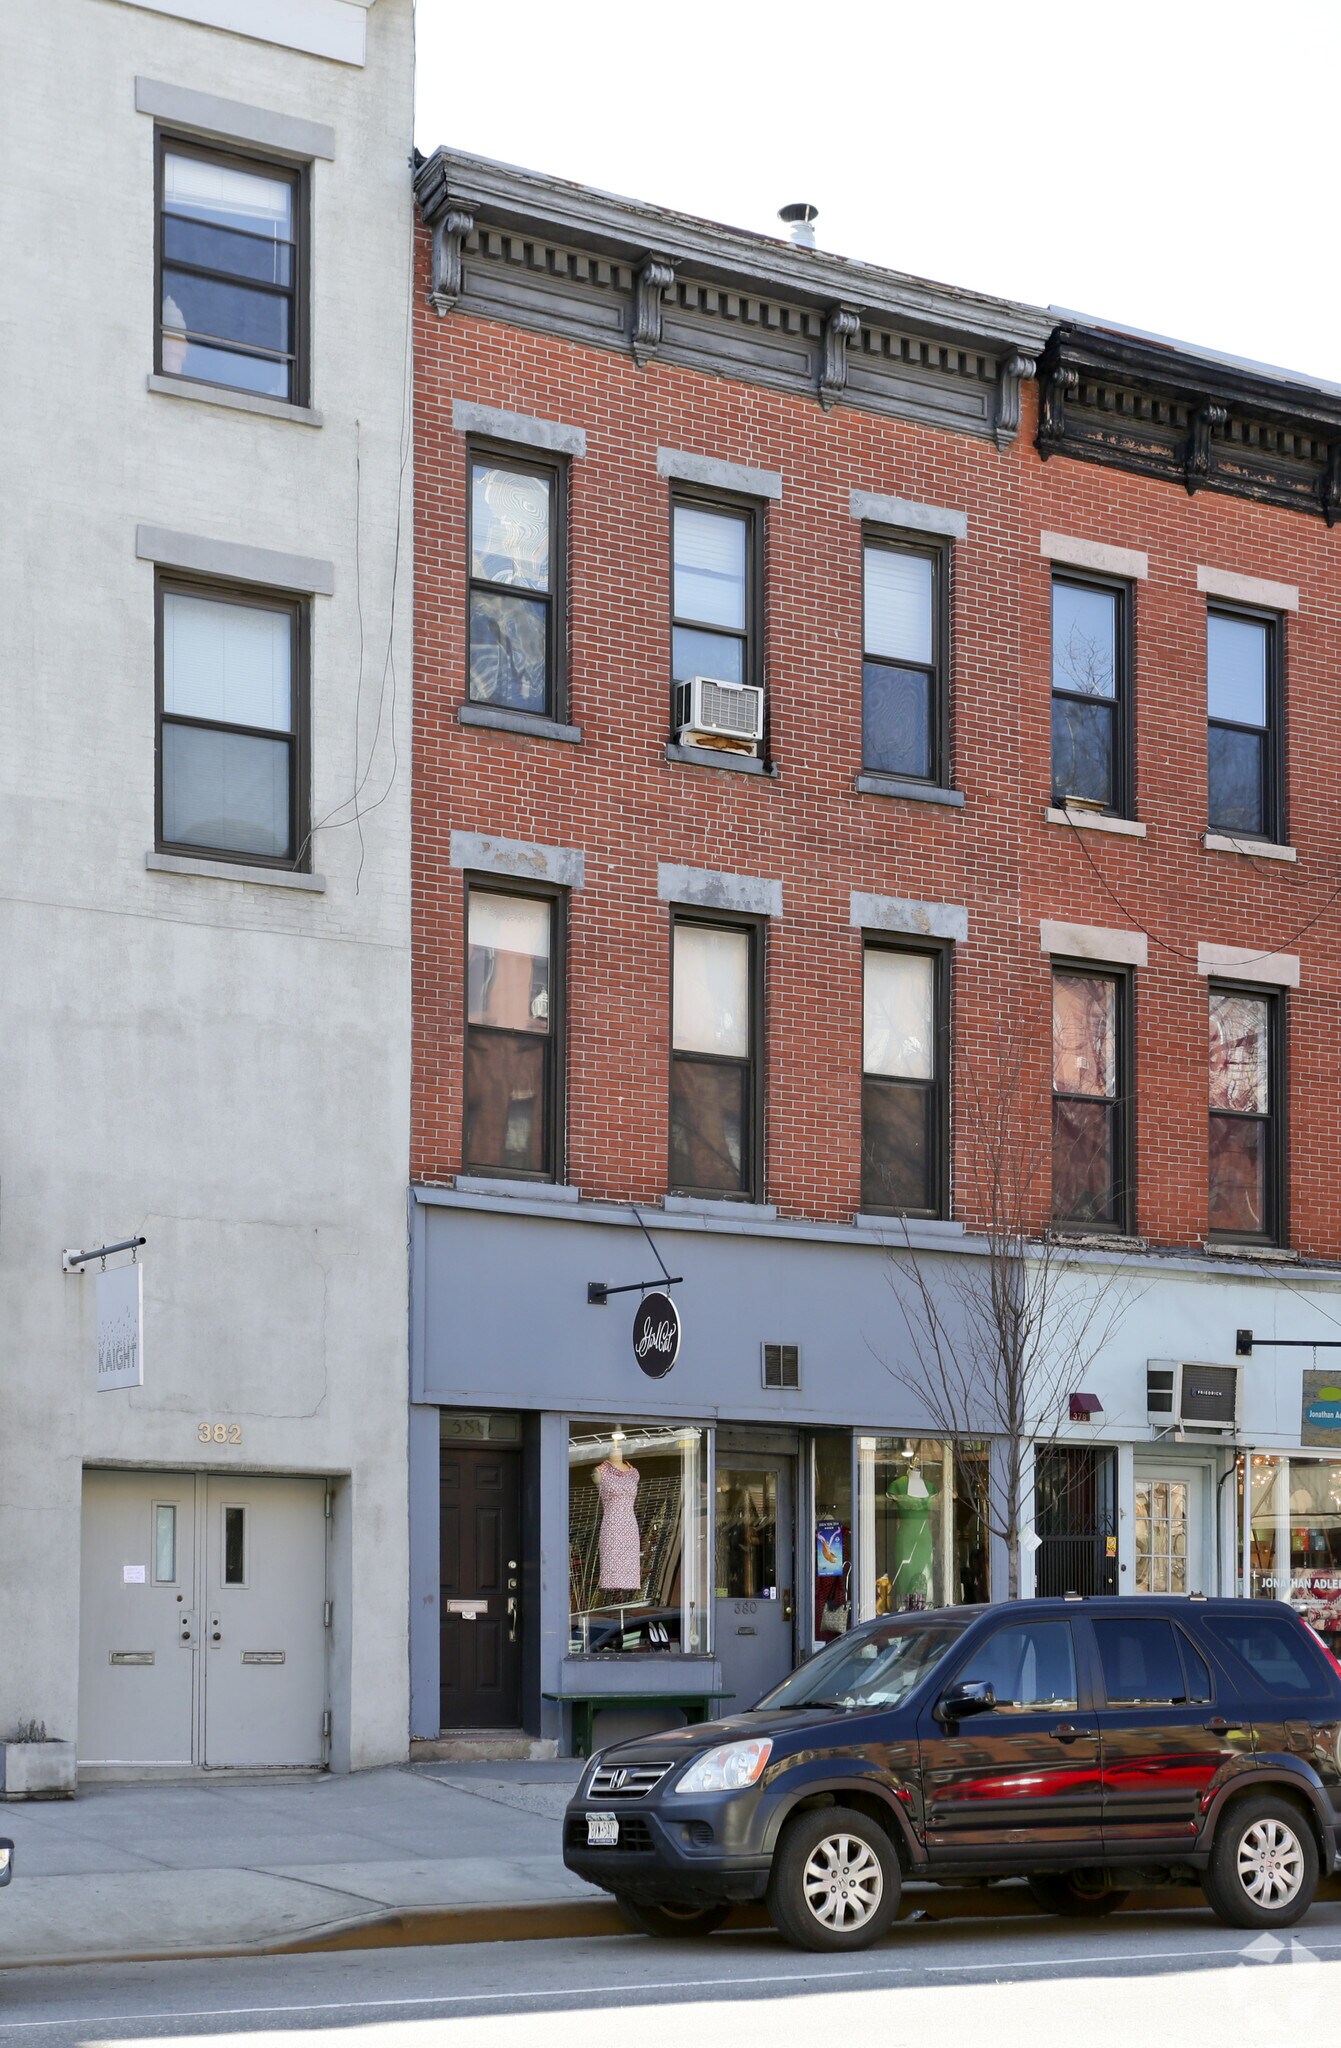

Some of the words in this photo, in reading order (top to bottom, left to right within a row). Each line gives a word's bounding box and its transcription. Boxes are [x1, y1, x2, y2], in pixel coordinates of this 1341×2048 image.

[98, 1341, 137, 1373] KAIGHT
[1072, 1412, 1087, 1421] 378
[1309, 1410, 1334, 1419] Jonathan
[198, 1422, 242, 1444] 382
[734, 1601, 757, 1615] 380
